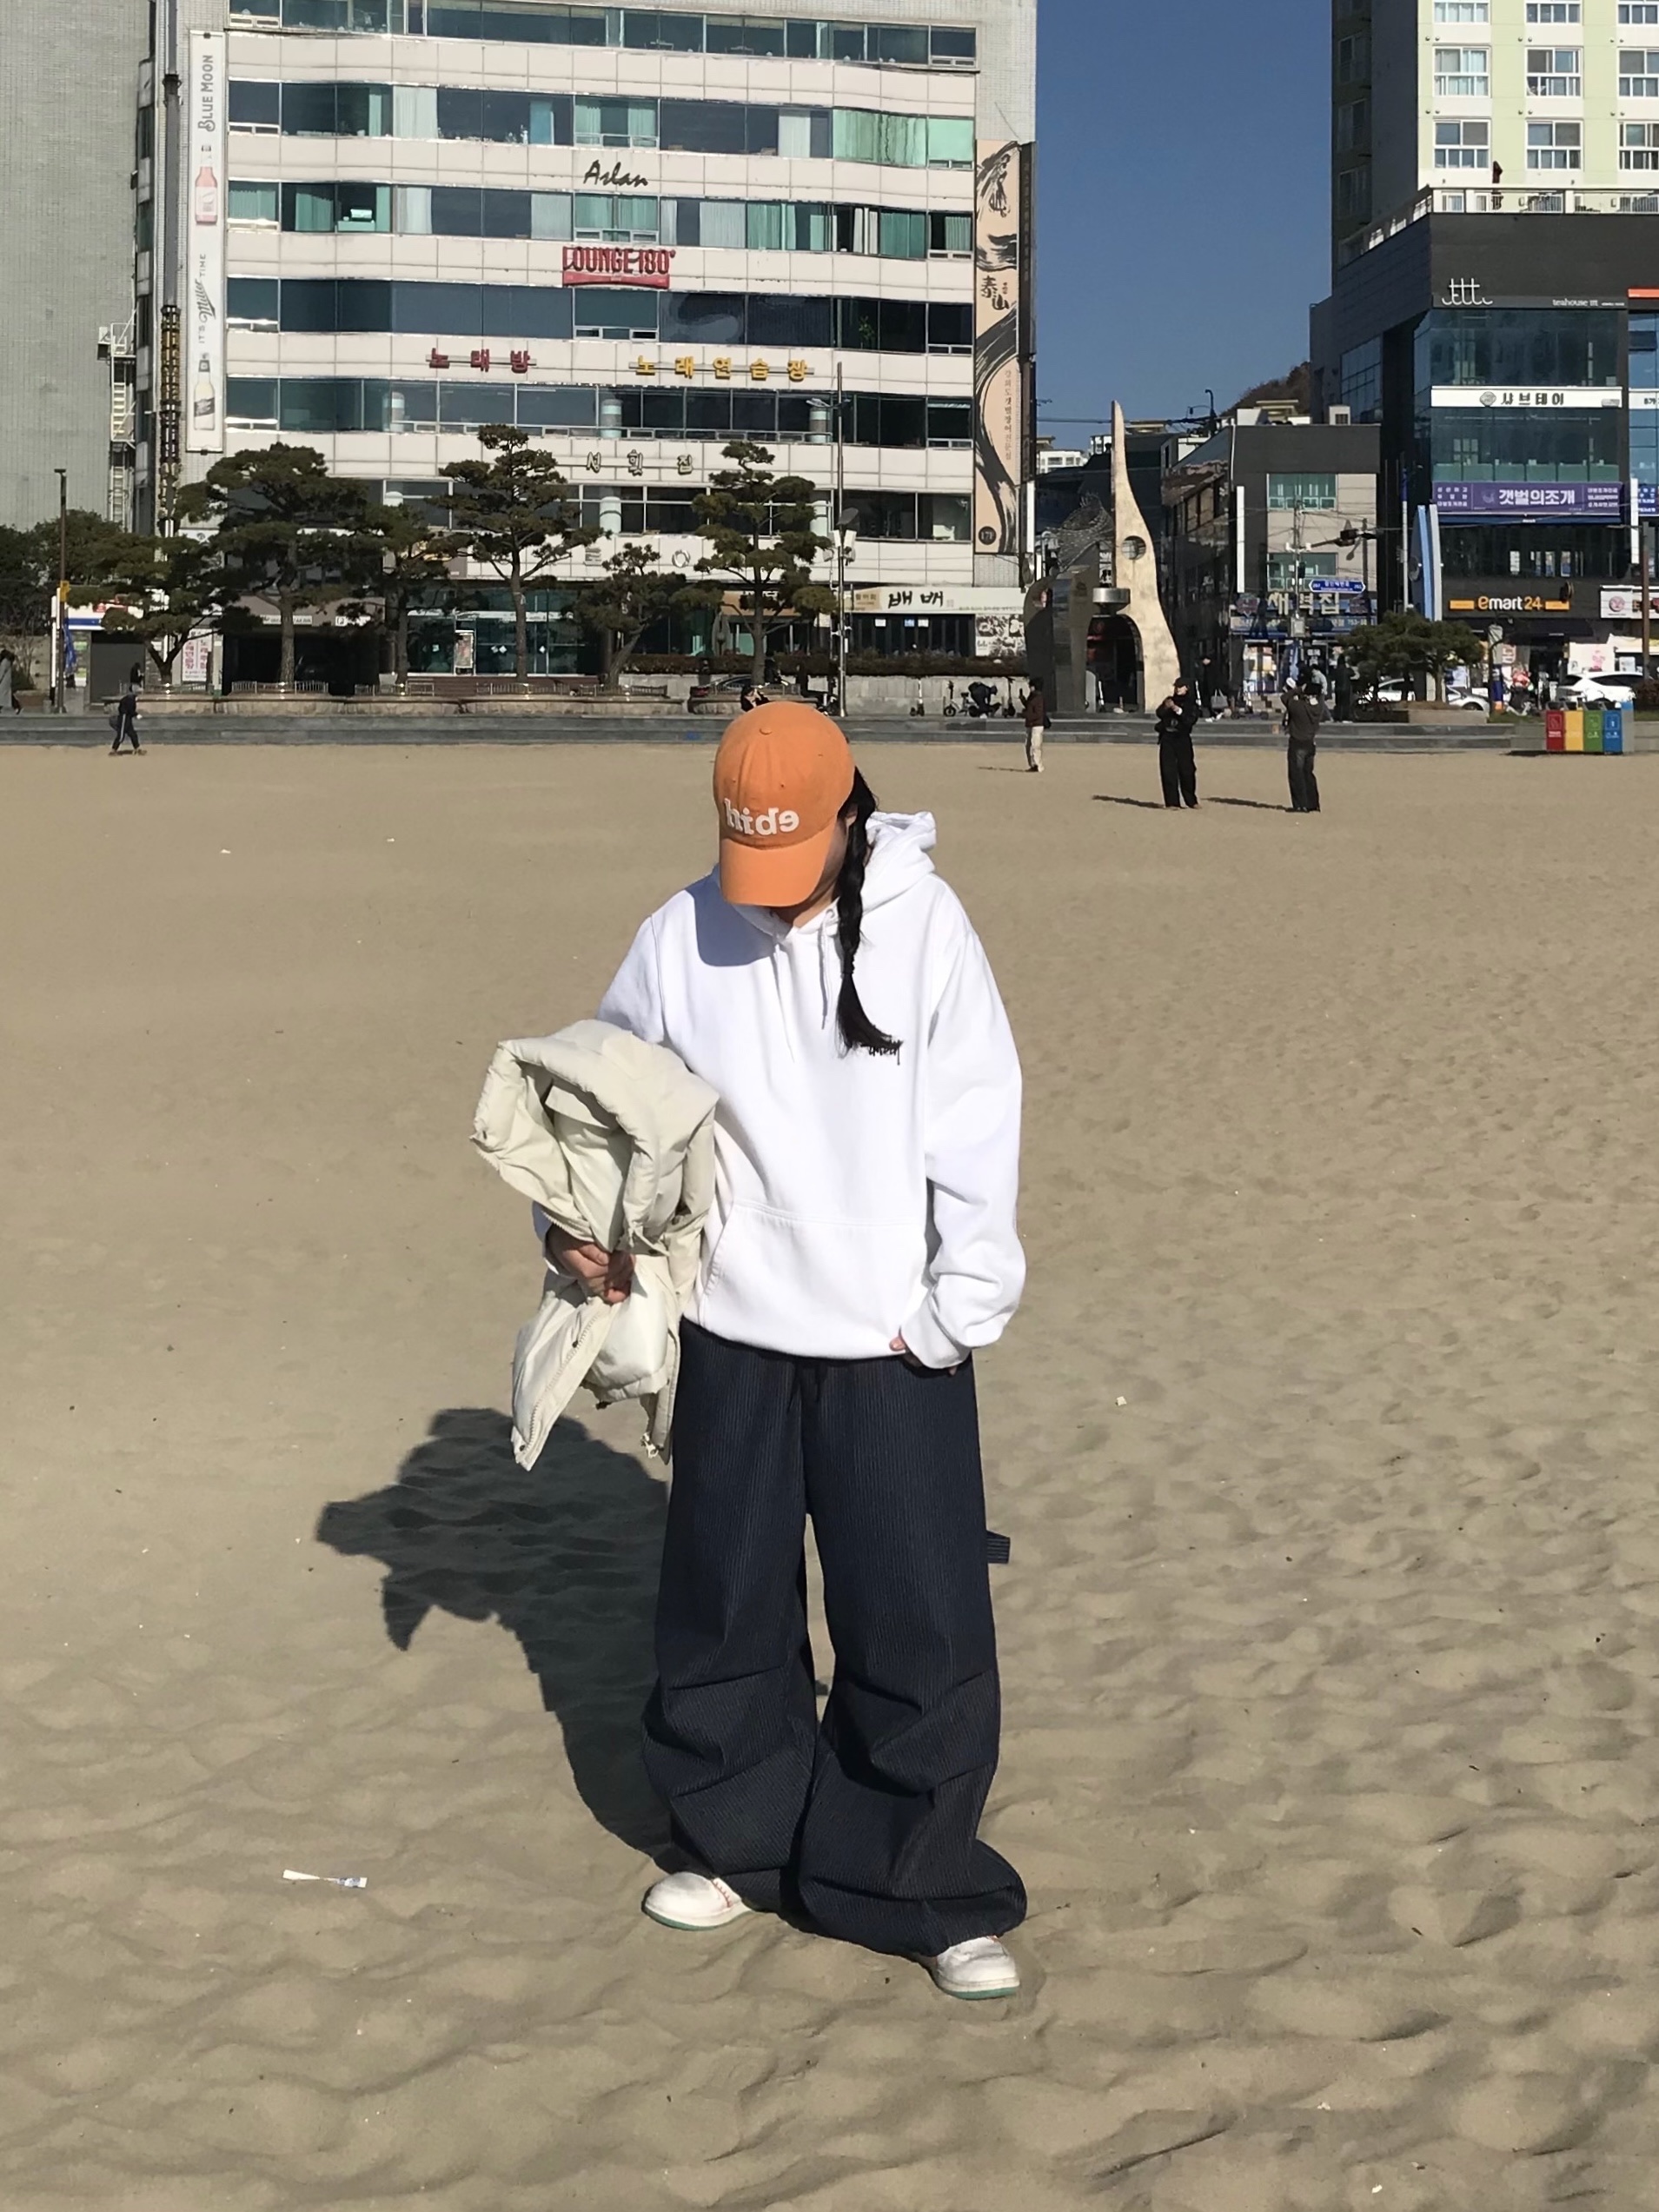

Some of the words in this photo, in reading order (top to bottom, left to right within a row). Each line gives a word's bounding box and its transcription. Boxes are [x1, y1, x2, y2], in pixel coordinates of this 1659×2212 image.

[201, 55, 214, 92] MOON
[197, 96, 216, 132] BLUE
[194, 278, 217, 324] Miller
[1552, 298, 1589, 307] teahouse
[428, 347, 531, 375] 노래방
[635, 355, 808, 382] 노래연습장
[1500, 392, 1564, 406] 샤브테이
[1498, 488, 1576, 506] 갯벌의조개
[1477, 595, 1543, 611] emart24
[723, 797, 800, 836] hide
